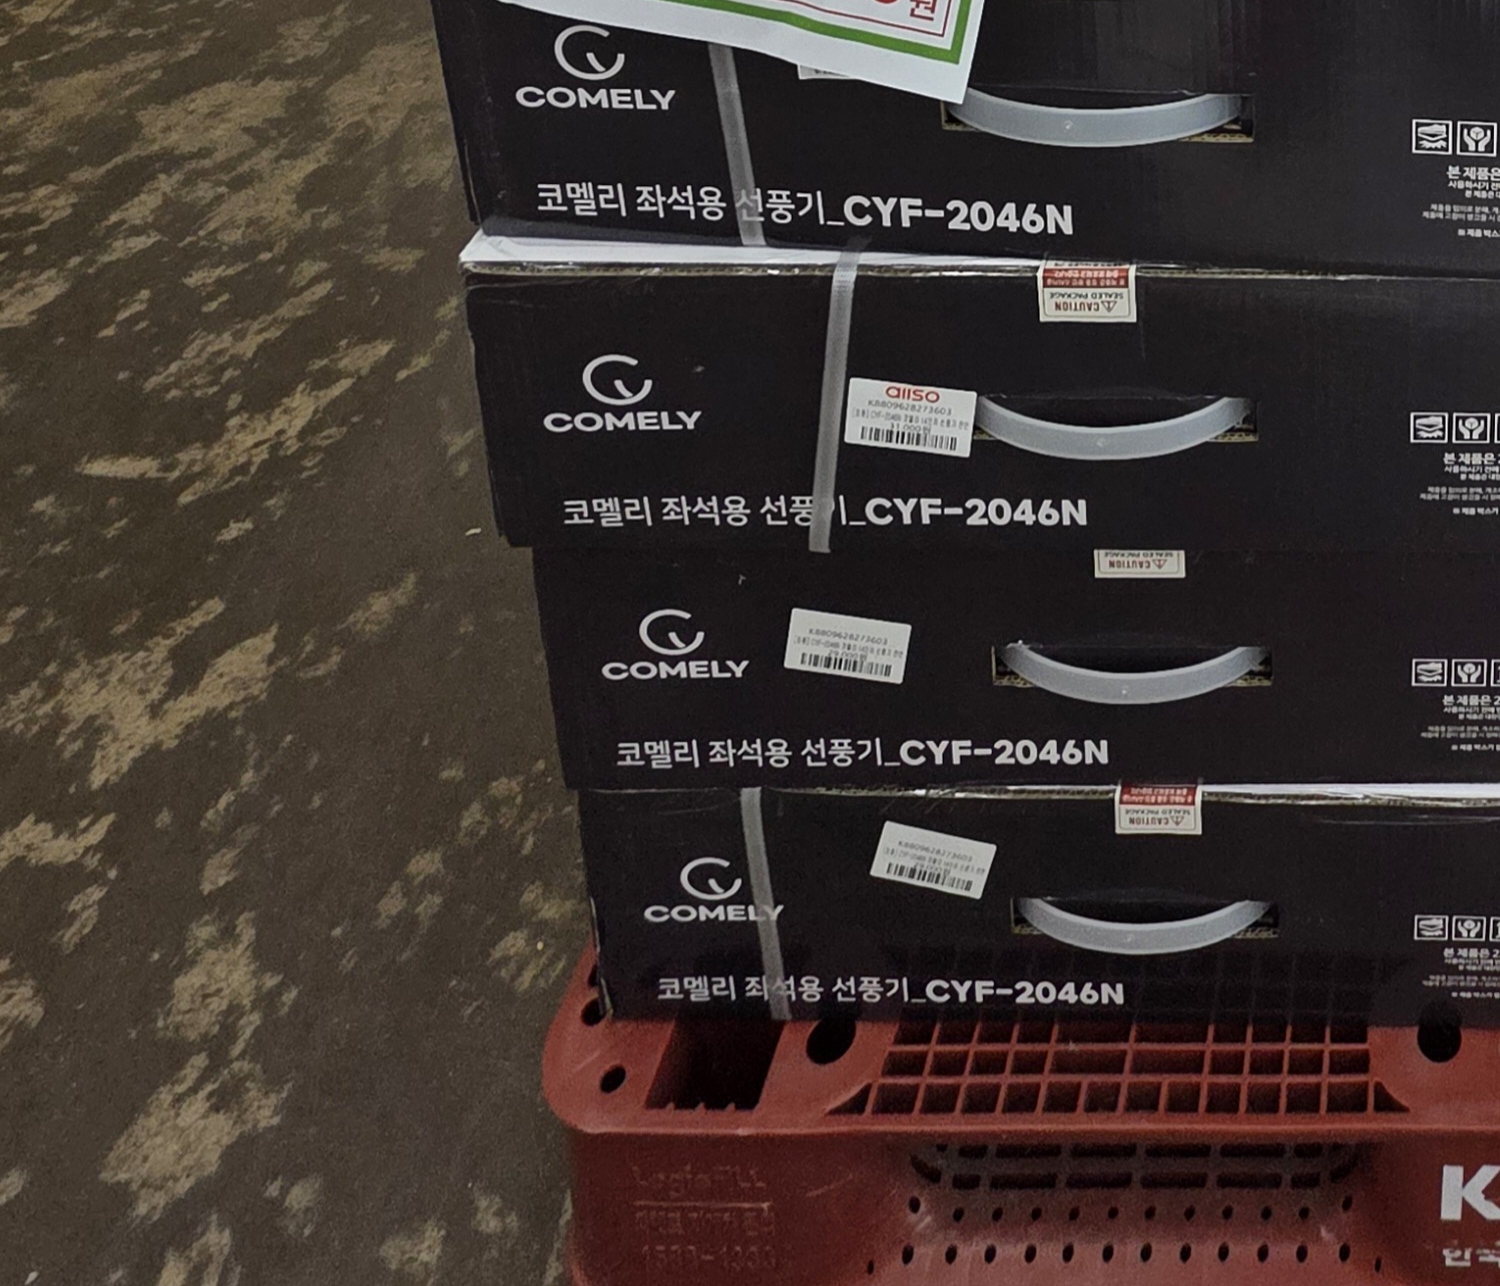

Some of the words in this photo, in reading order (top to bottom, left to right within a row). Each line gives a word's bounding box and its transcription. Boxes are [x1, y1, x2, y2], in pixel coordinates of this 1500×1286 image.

[515, 86, 676, 111] COMELY
[535, 182, 627, 218] 코멜리
[633, 183, 729, 221] 좌석용
[1049, 291, 1090, 301] PACKAGE
[1054, 300, 1101, 313] CAUTION
[1089, 291, 1125, 301] SEALED
[543, 409, 703, 434] COMELY
[562, 496, 652, 529] 코멜리
[660, 495, 753, 529] 좌석용
[1108, 559, 1152, 570] CAUTION
[601, 660, 750, 682] COMELY
[615, 739, 701, 770] 코멜리
[707, 738, 793, 770] 좌석용
[1128, 815, 1170, 827] CAUTION
[642, 902, 785, 924] COMELY
[656, 976, 737, 1003] 코멜리
[744, 976, 826, 1003] 좌석용
